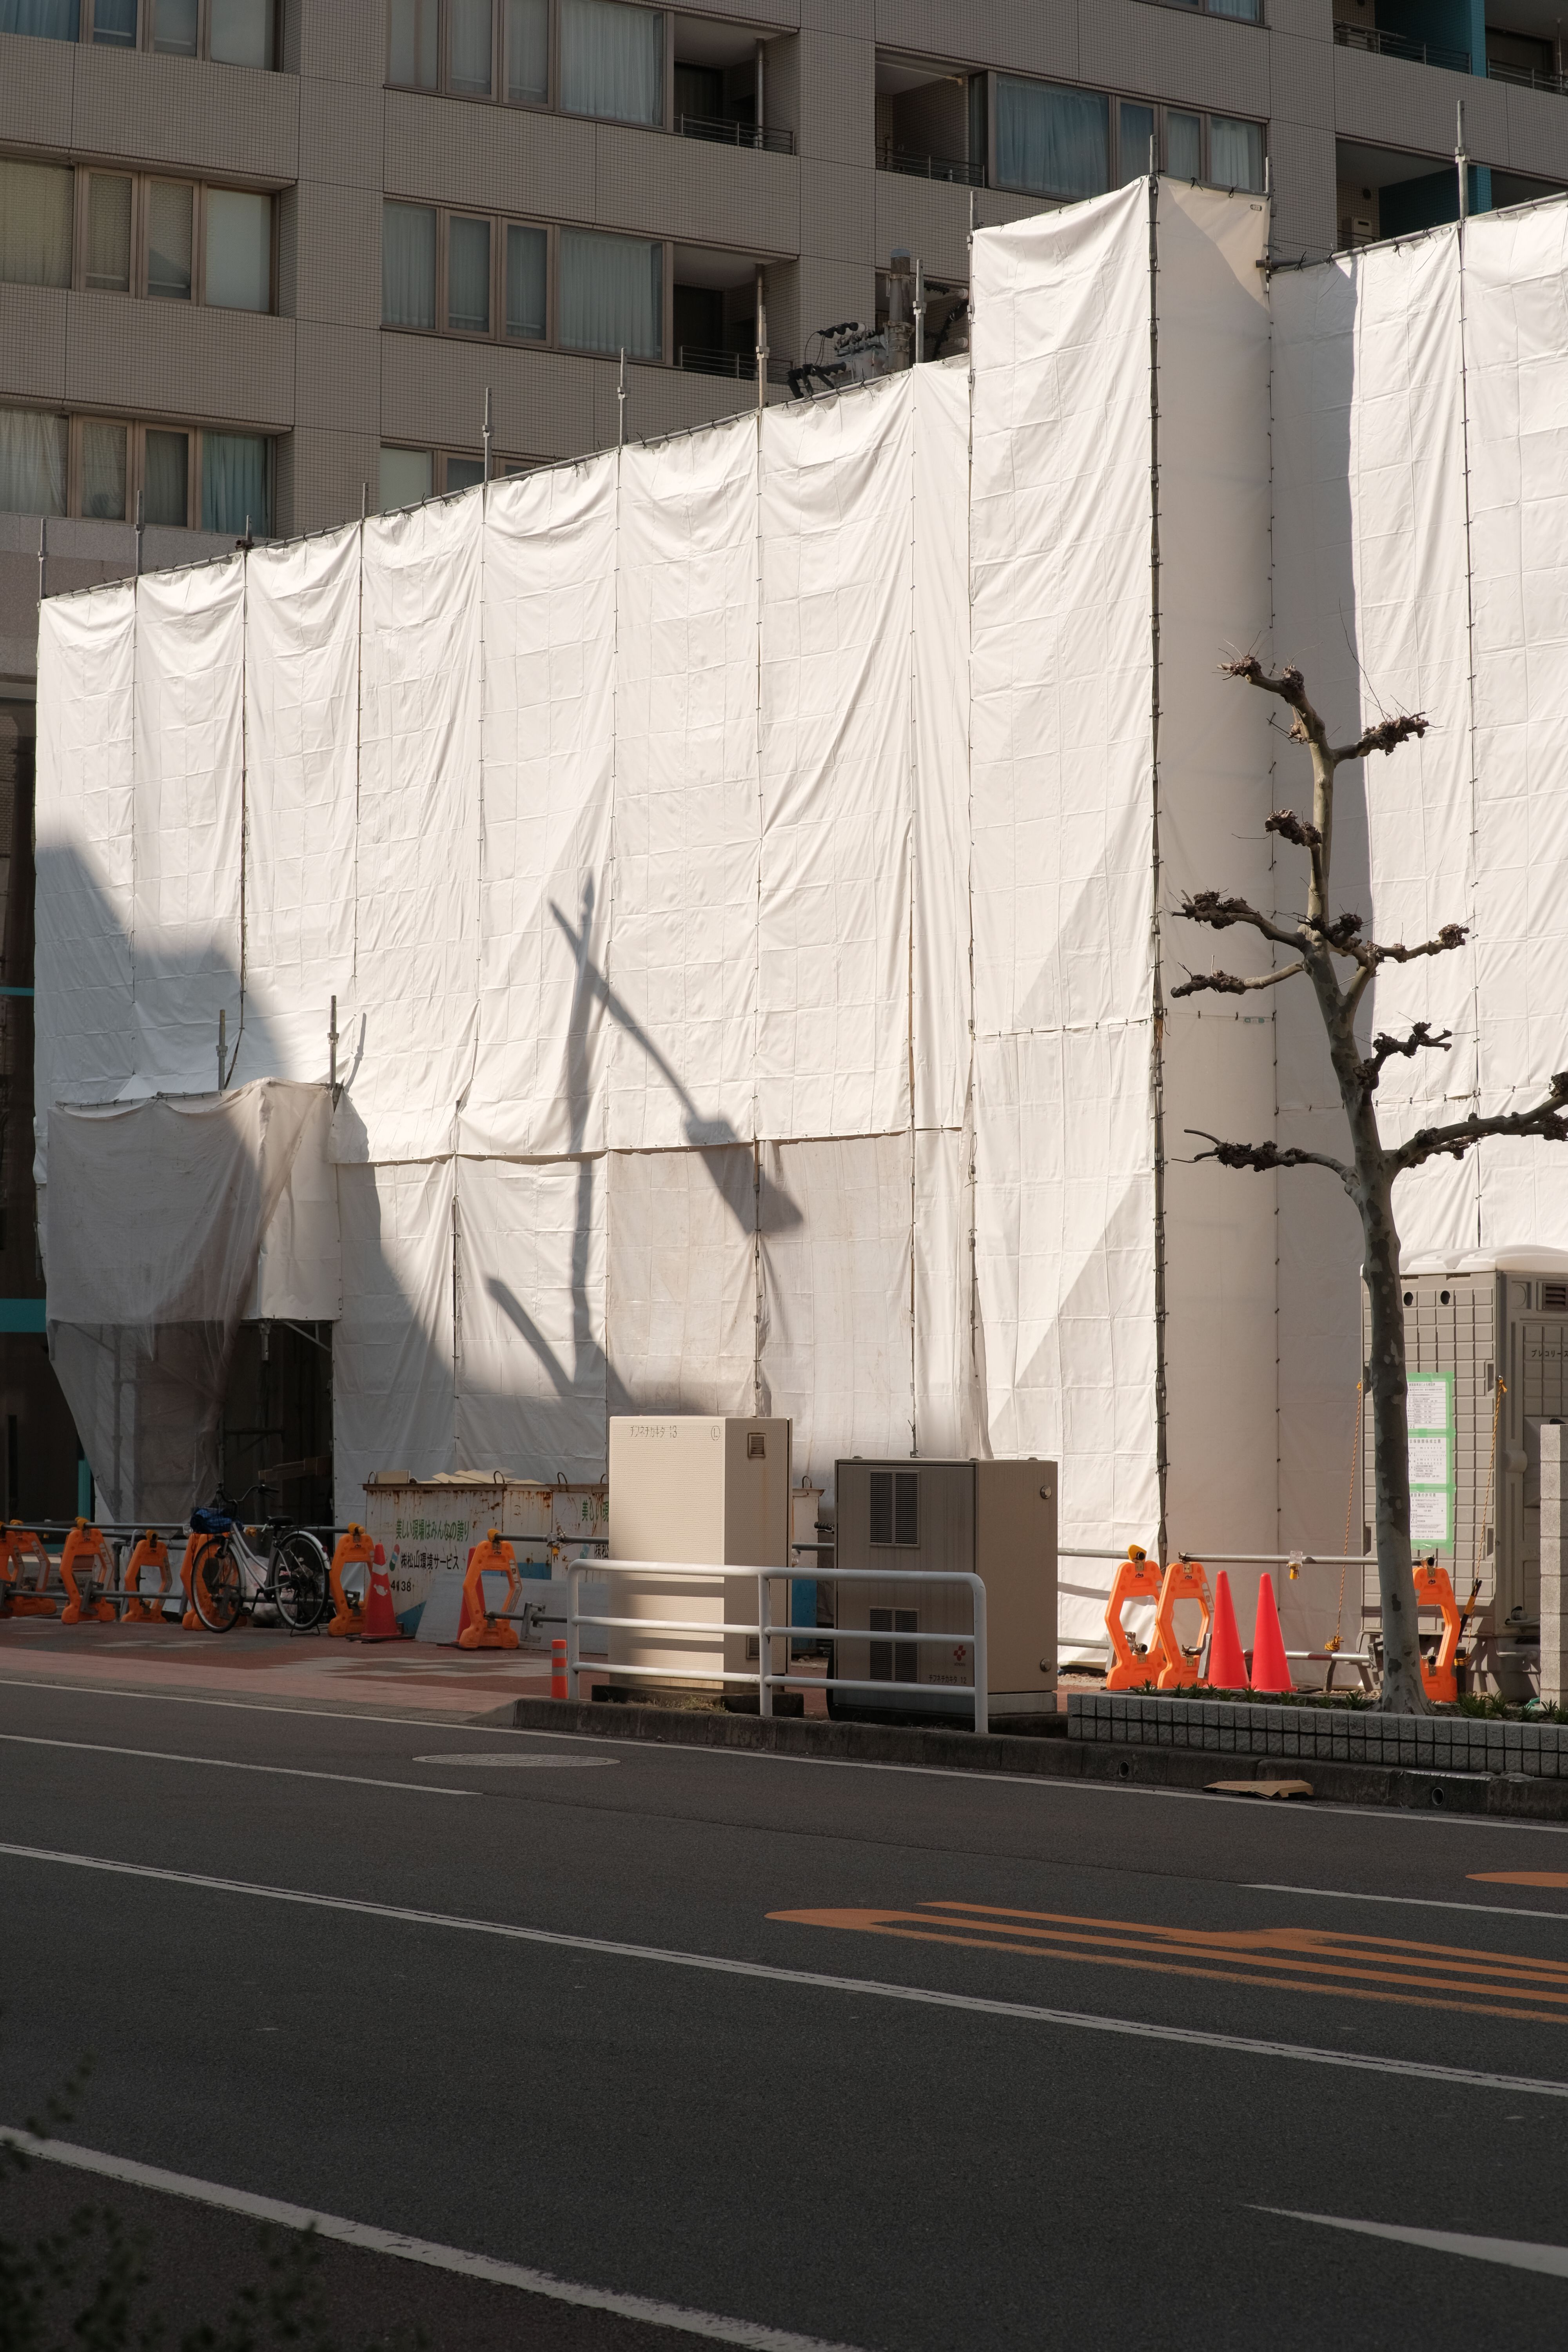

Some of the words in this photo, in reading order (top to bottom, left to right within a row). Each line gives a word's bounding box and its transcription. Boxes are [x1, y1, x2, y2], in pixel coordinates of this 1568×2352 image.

[396, 1518, 469, 1542] 美しい現場はみんなの誇り
[928, 1675, 957, 1684] チフネチカキタ
